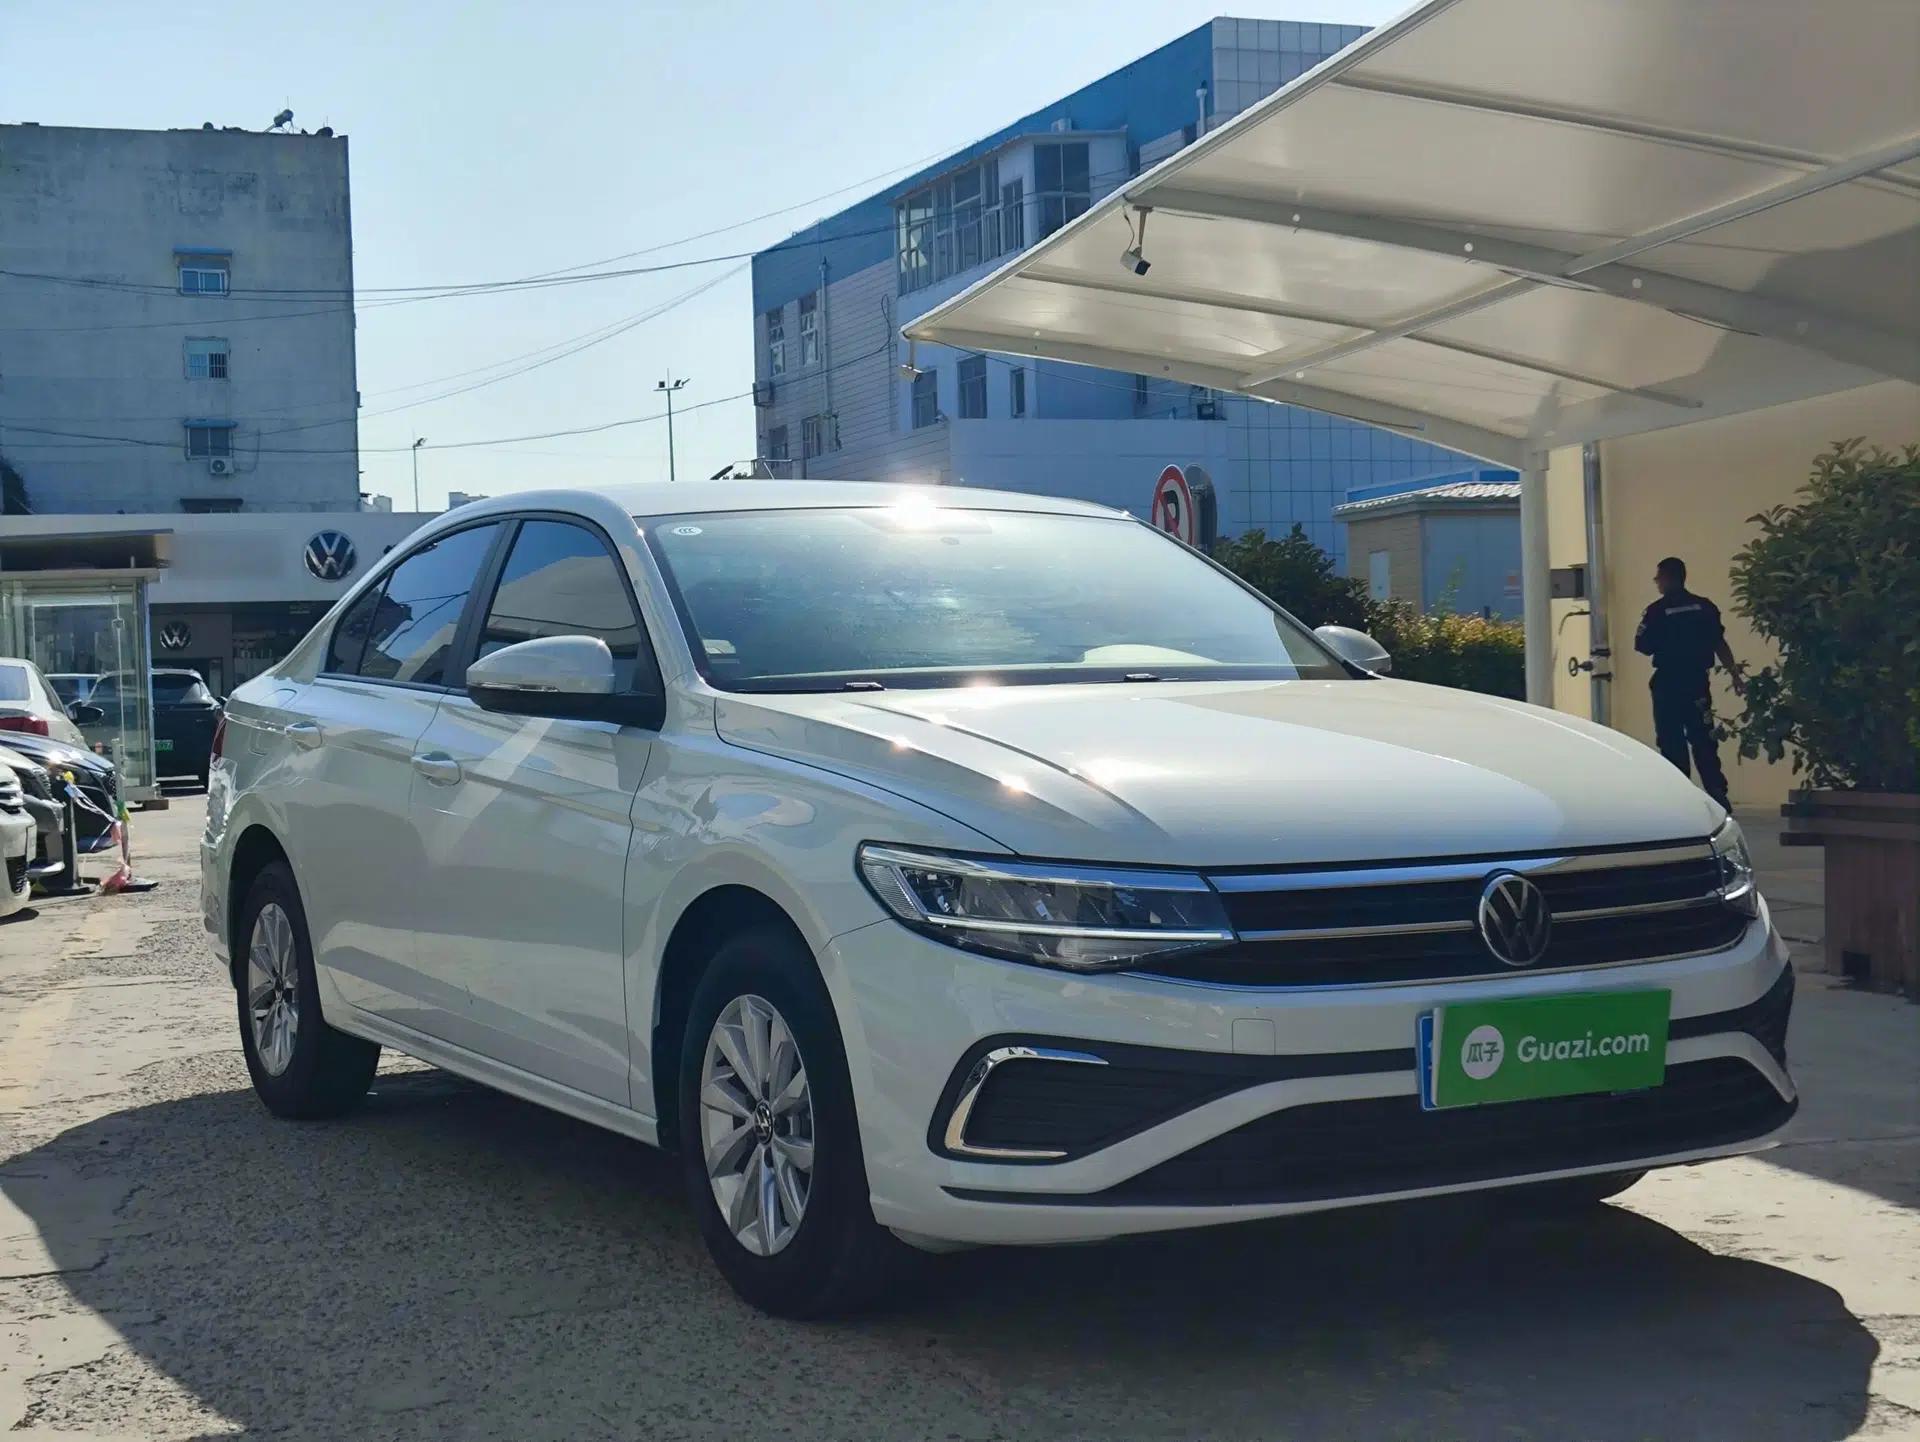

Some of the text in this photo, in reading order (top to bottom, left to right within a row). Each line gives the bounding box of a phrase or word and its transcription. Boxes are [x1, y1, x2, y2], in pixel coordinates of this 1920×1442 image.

[306, 532, 355, 580] VW
[1481, 878, 1545, 961] VW
[1466, 1030, 1649, 1063] 瓜子 Guazi.com
